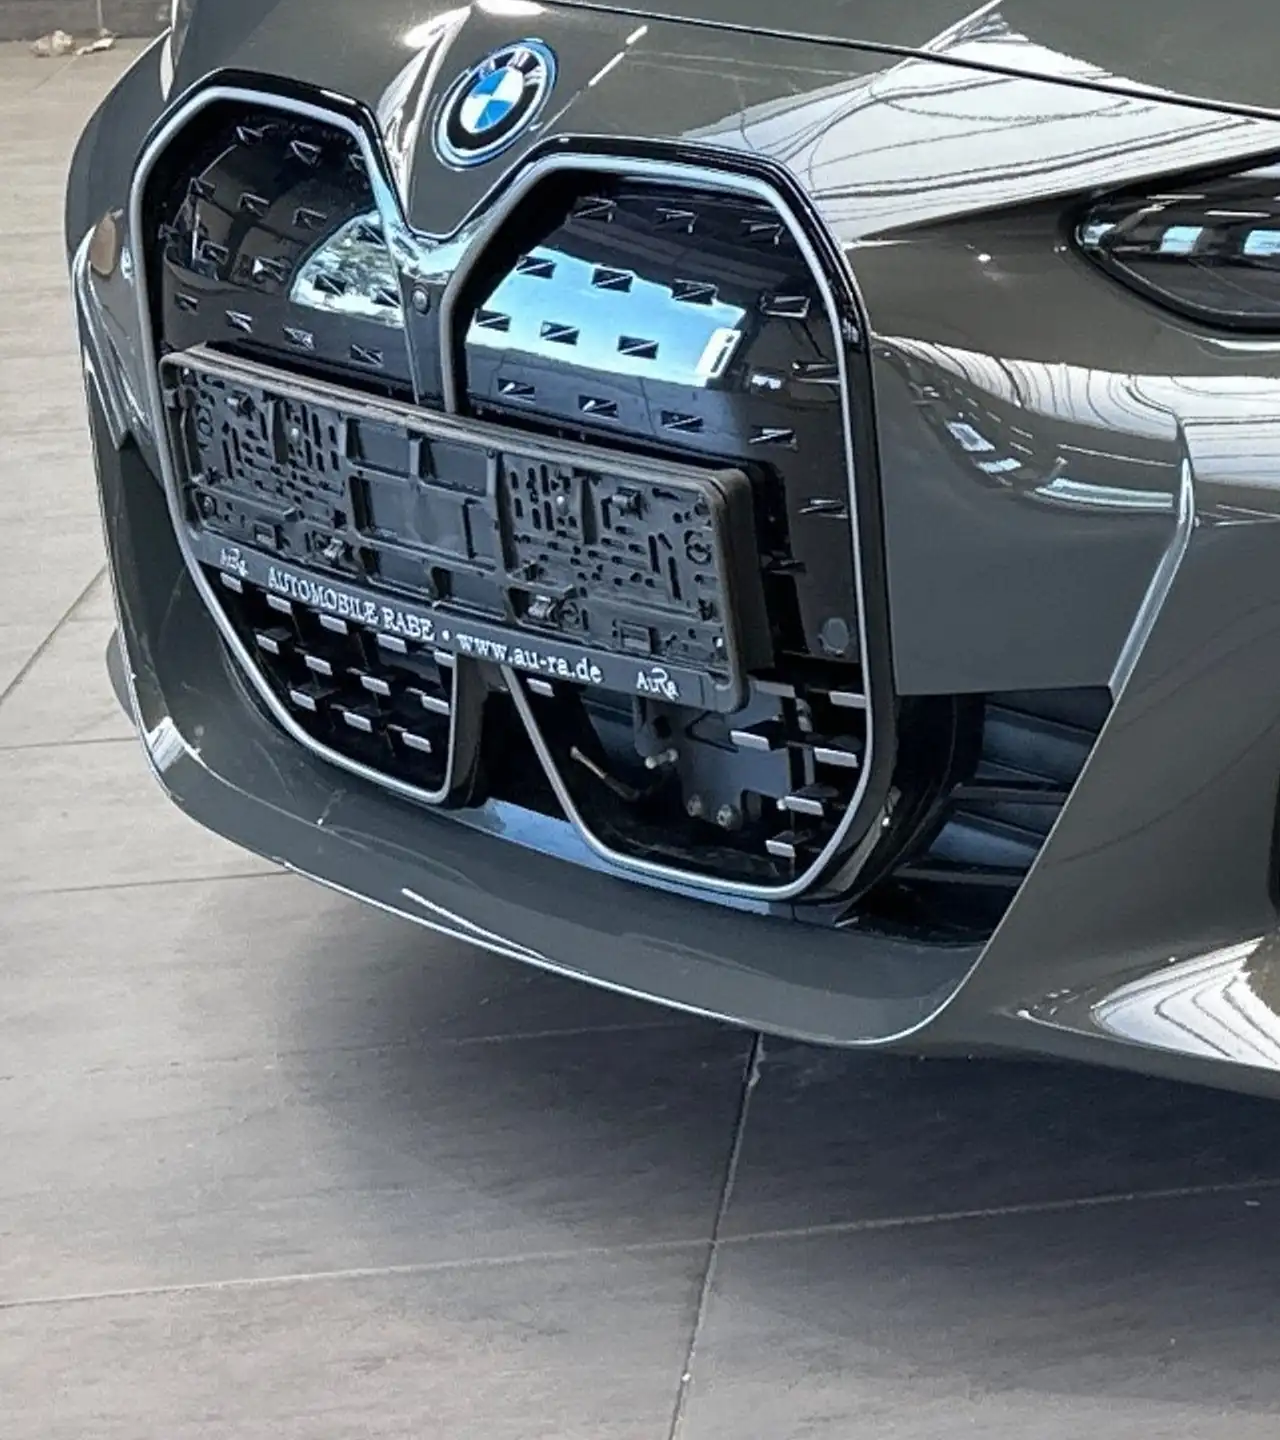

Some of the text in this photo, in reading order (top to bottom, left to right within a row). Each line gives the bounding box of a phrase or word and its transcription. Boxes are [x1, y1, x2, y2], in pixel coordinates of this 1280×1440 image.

[267, 566, 378, 624] AUTOMOBILE
[381, 606, 435, 641] RABE
[457, 633, 603, 684] www.au-ra.de
